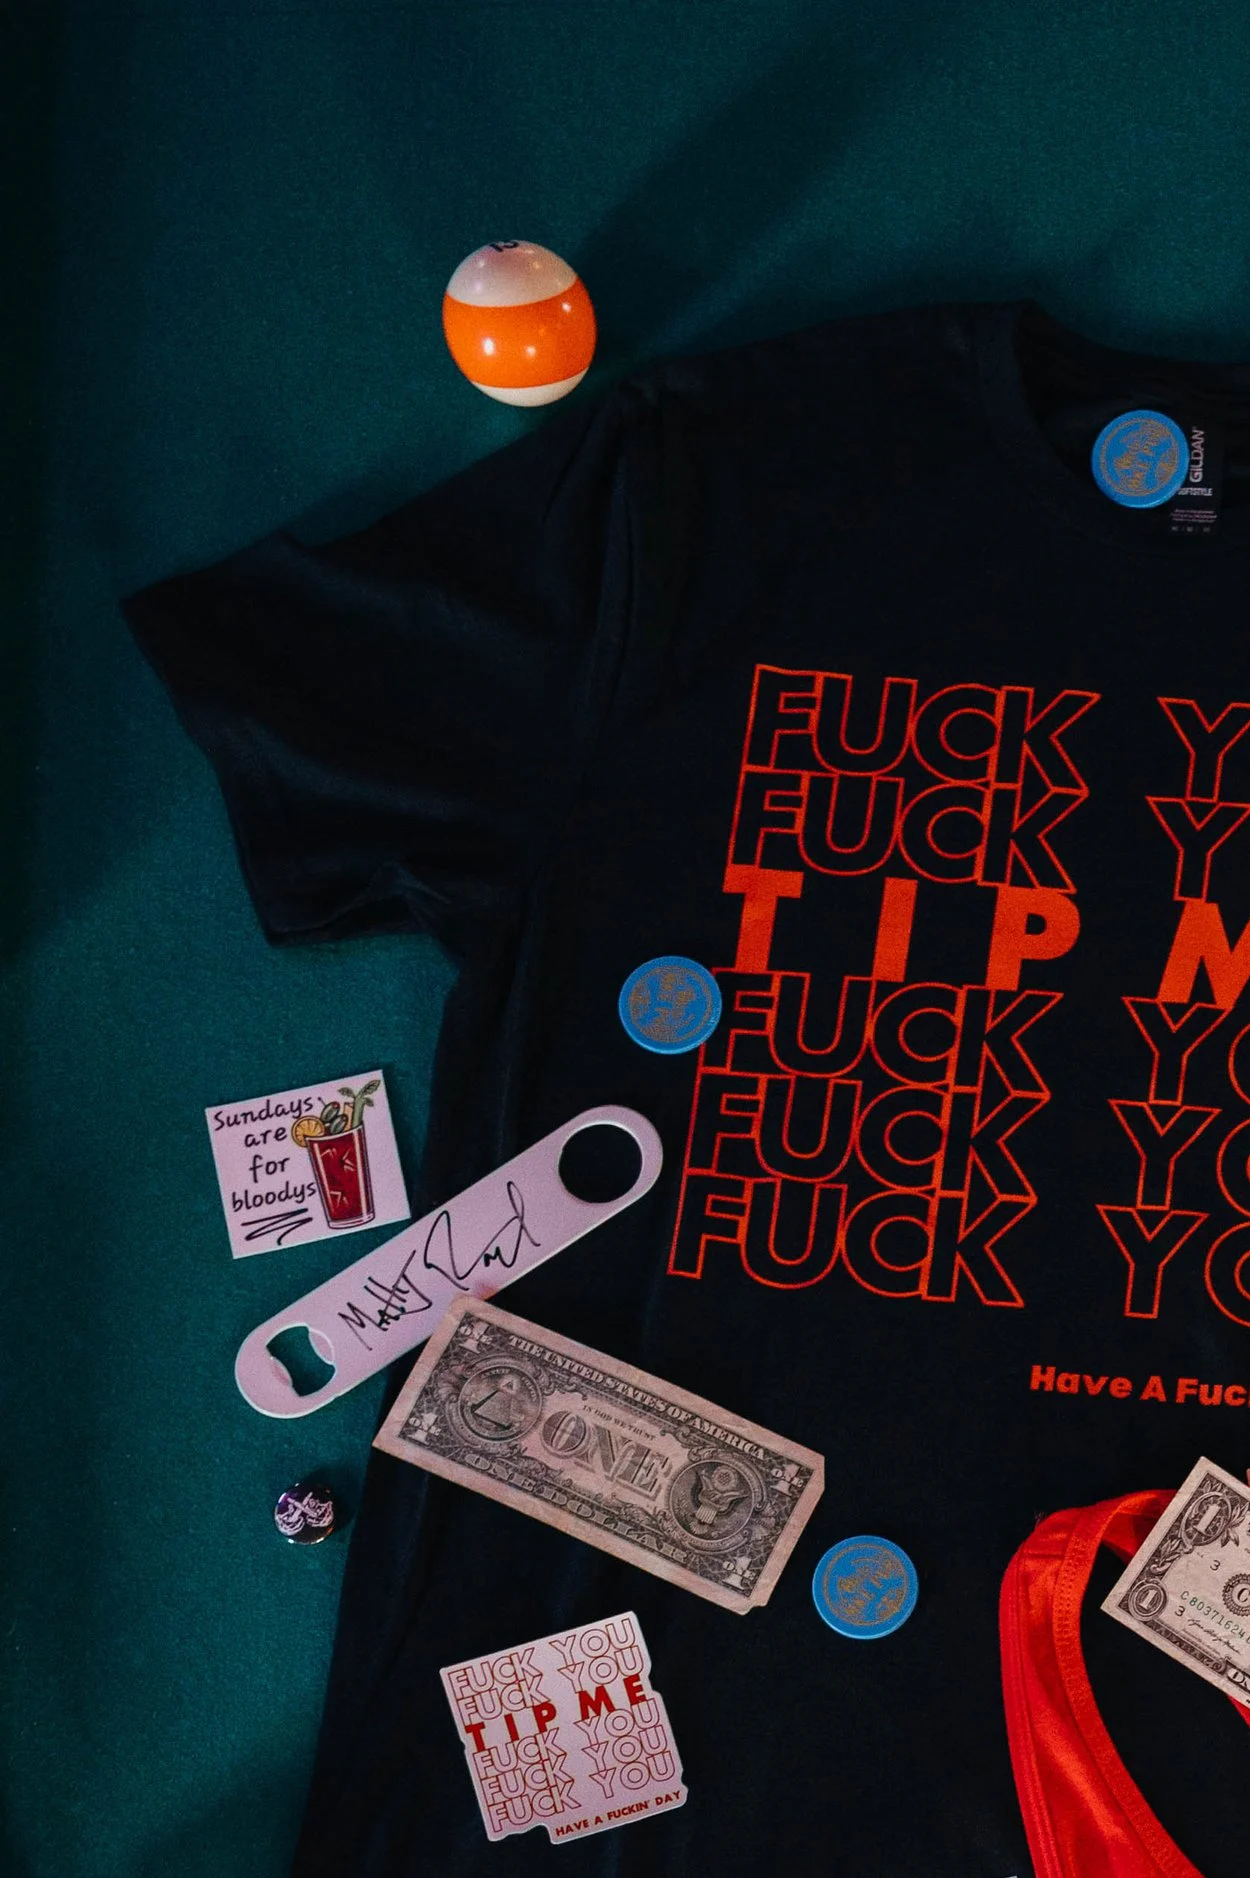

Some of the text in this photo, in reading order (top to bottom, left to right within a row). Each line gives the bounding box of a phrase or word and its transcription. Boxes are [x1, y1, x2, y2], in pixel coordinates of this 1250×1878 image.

[1189, 428, 1205, 483] GILDAN
[743, 663, 1101, 796] FUCK
[728, 768, 1089, 893] FUCK
[723, 864, 1081, 991] TIP
[701, 967, 1064, 1098] FUCK
[212, 1095, 314, 1131] Sundays
[243, 1126, 287, 1148] are
[685, 1067, 1051, 1202] FUCK
[231, 1180, 318, 1213] bloodys
[248, 1154, 291, 1183] for
[667, 1171, 1038, 1309] FUCK
[508, 1334, 542, 1359] THE
[545, 1350, 603, 1383] UNITED
[603, 1377, 668, 1413] STATES
[691, 1417, 766, 1460] AMERICA
[1029, 1364, 1133, 1401] Have
[1141, 1375, 1168, 1403] A
[541, 1409, 670, 1501] ONE
[448, 1618, 636, 1701] FUCK YOU
[456, 1645, 644, 1726] FUCK YOU
[465, 1673, 647, 1752] TIP ME
[472, 1698, 660, 1780] FUCK YOU
[480, 1724, 668, 1806] FUCK YOU
[487, 1750, 676, 1833] FUCK YOU
[555, 1790, 681, 1837] HAVE A FUCKIN' DAY
